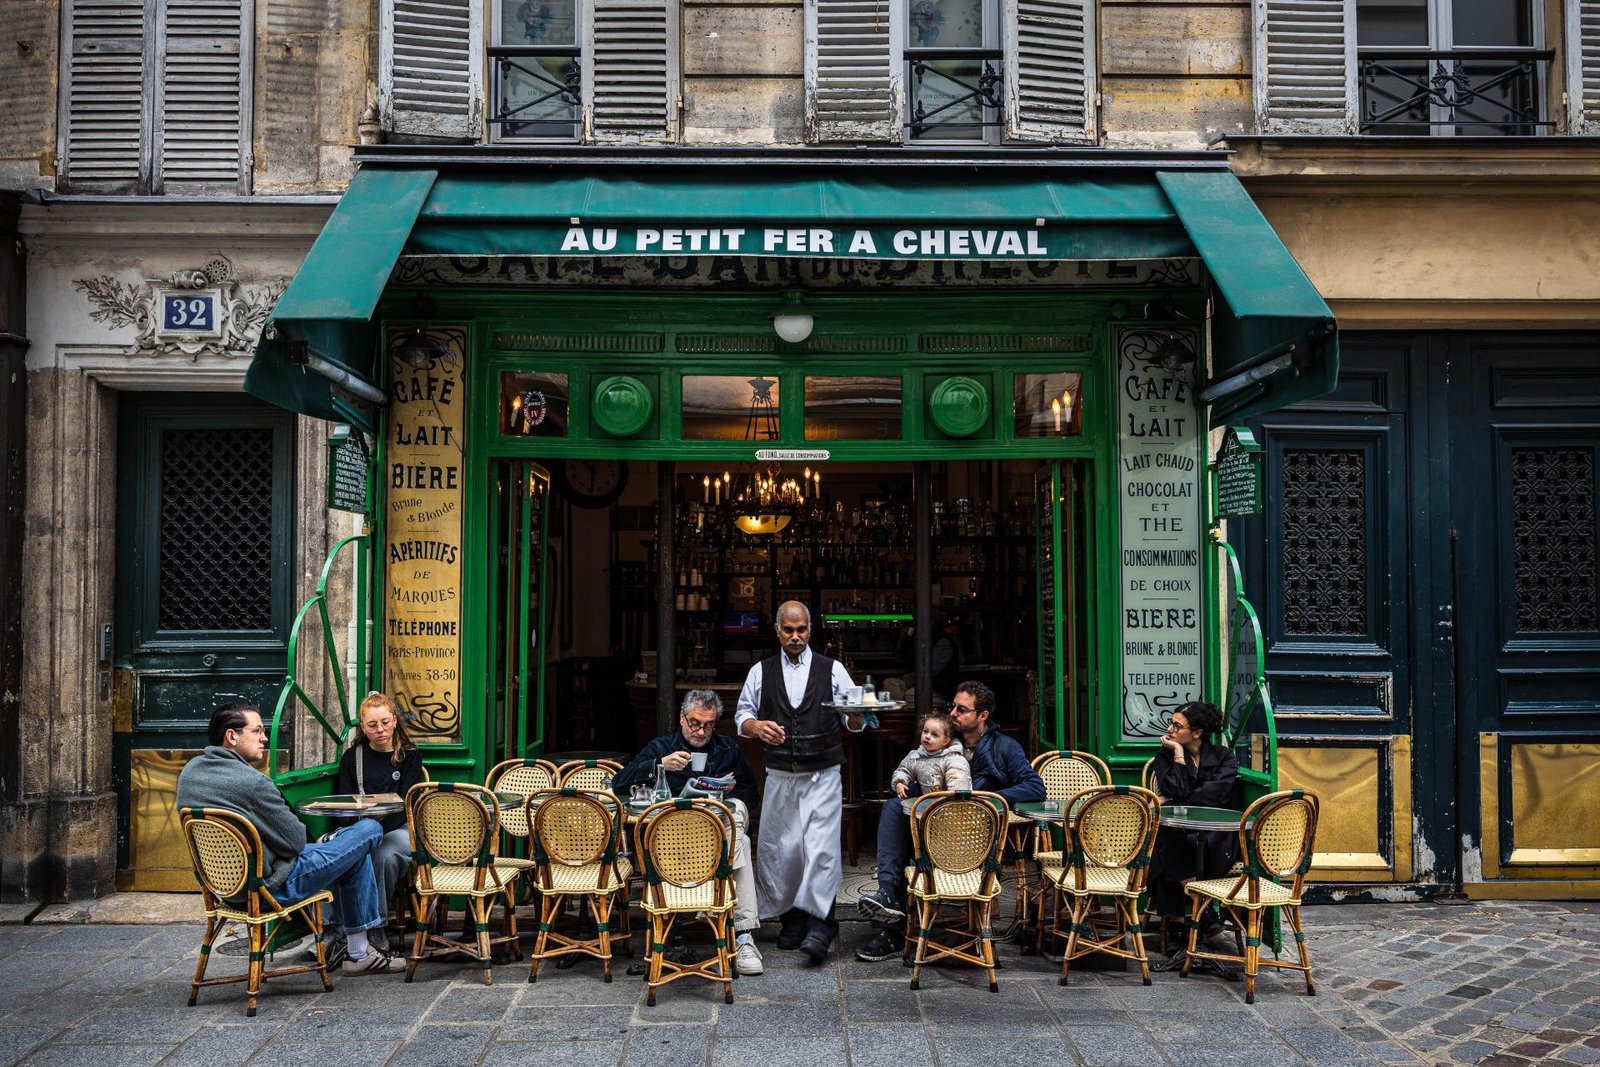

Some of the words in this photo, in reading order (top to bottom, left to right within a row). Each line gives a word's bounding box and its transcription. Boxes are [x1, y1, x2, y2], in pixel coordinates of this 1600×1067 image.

[560, 228, 617, 251] AU
[635, 228, 745, 251] PETIT
[763, 229, 834, 253] FER
[848, 230, 877, 254] A
[893, 230, 1048, 255] CHEVAL
[172, 299, 206, 326] 32
[394, 377, 455, 405] CAFÉ
[417, 409, 434, 417] ET
[531, 410, 539, 418] IV
[1149, 405, 1168, 413] ET
[1128, 413, 1186, 437] LAIT
[396, 423, 453, 446] LAIT
[1123, 454, 1151, 472] LAIT
[1155, 453, 1194, 472] CHAUD
[391, 461, 458, 489] BIÈRE
[1127, 482, 1193, 498] CHOCOLAT
[391, 498, 423, 513] Brune
[406, 514, 416, 523] &
[417, 501, 455, 523] Blonde
[1151, 503, 1170, 512] ET
[1139, 517, 1183, 531] THE
[390, 538, 459, 565] APÉRITIFS
[1123, 549, 1197, 567] CONSOMMATIONS
[413, 571, 431, 580] DE
[1130, 580, 1147, 591] DE
[1153, 580, 1192, 591] CHOIX
[390, 587, 456, 605] MARQUES
[389, 618, 457, 636] TÉLÉPHONE
[1125, 608, 1196, 629] BIERE
[388, 645, 456, 659] Paris-Province
[1125, 641, 1154, 656] BRUNE
[1157, 643, 1166, 656] &
[1167, 641, 1198, 656] BLONDE
[388, 668, 422, 681] Archives
[425, 668, 456, 681] 38-50
[1128, 673, 1196, 686] TELEPHONE
